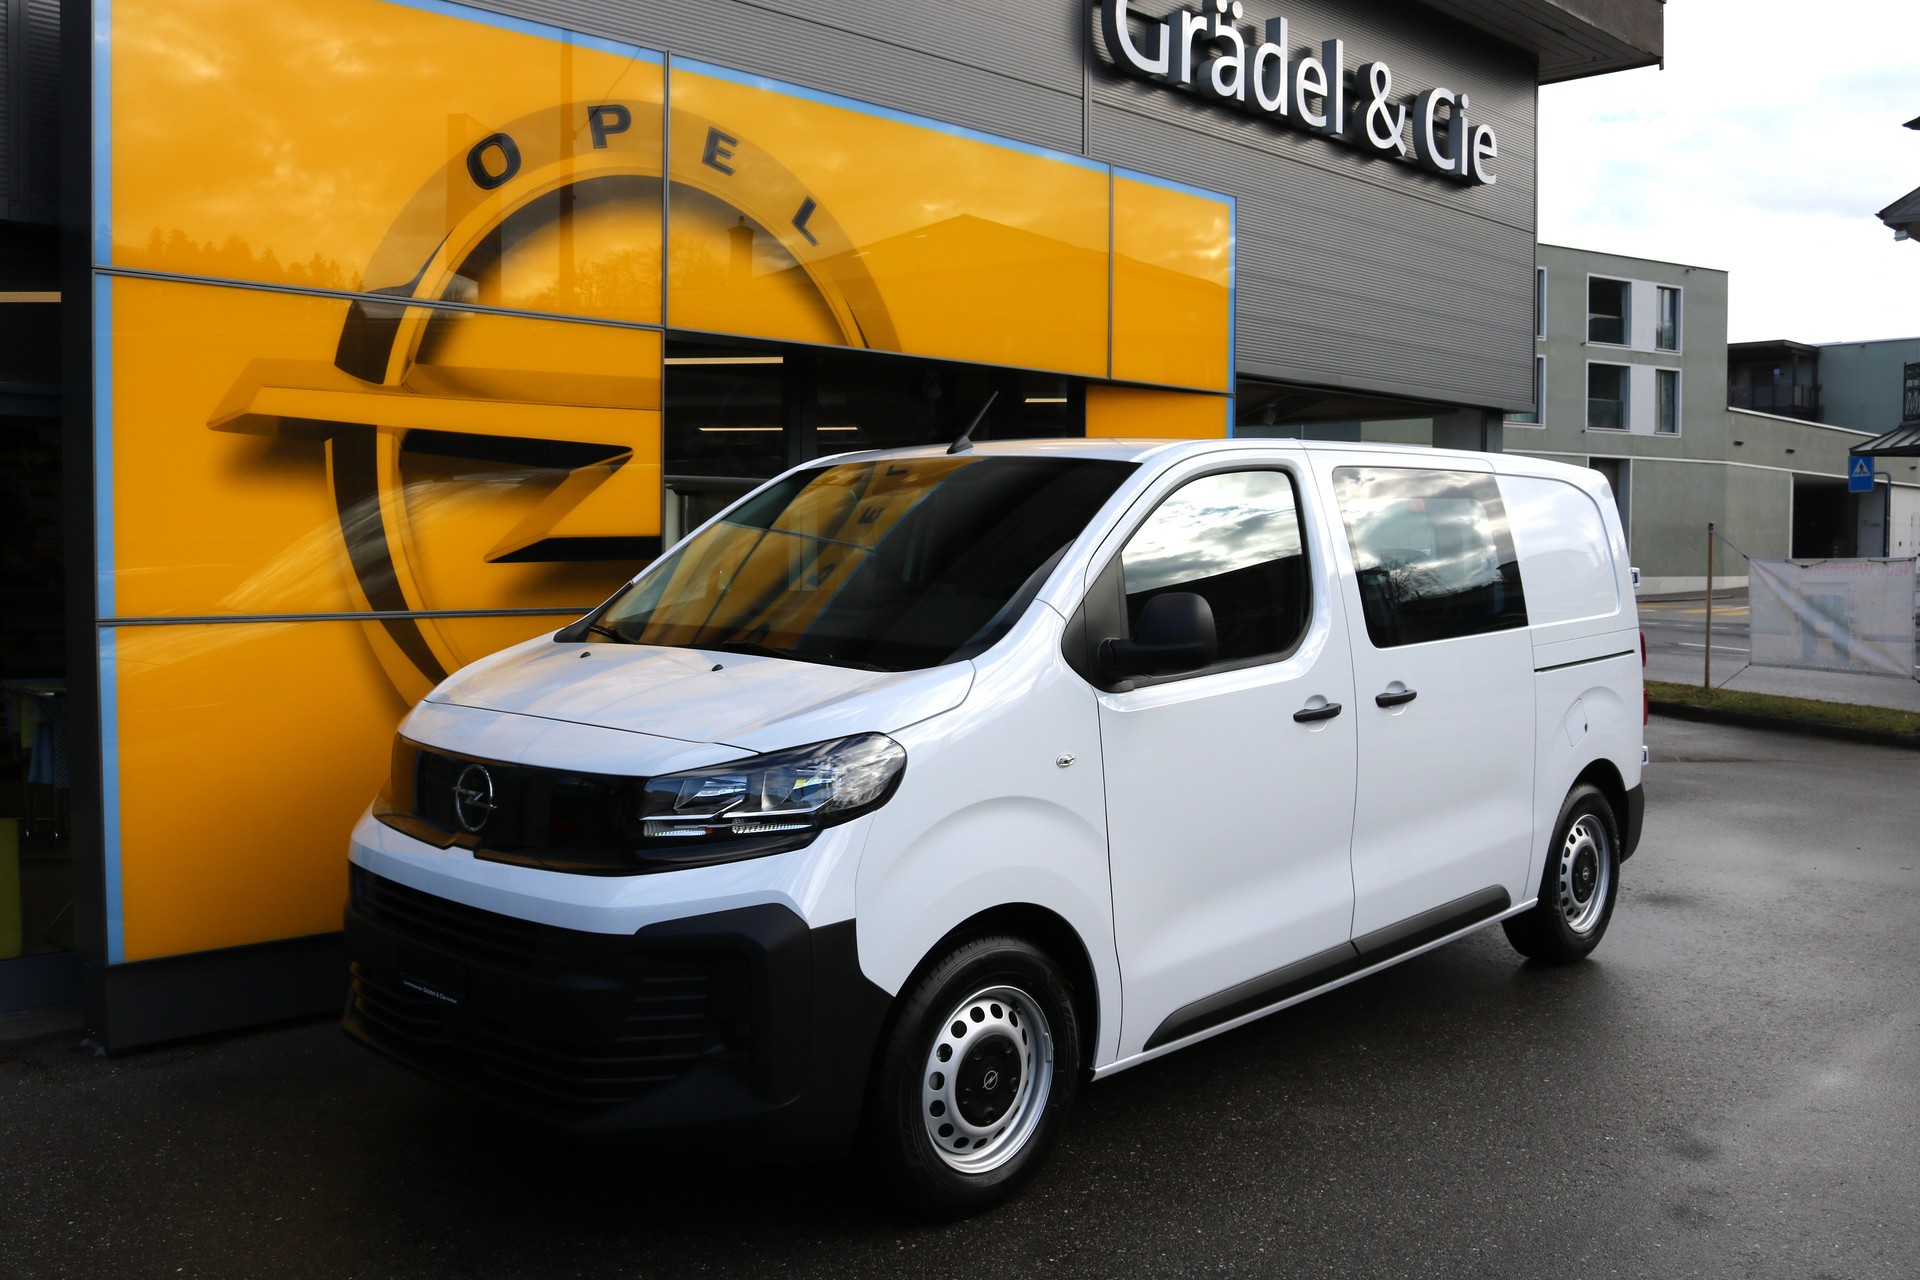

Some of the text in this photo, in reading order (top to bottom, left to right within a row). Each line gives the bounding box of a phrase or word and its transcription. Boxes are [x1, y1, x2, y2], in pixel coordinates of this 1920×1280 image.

[1102, 0, 1498, 185] Grädel & Cie
[466, 103, 820, 247] OPEL
